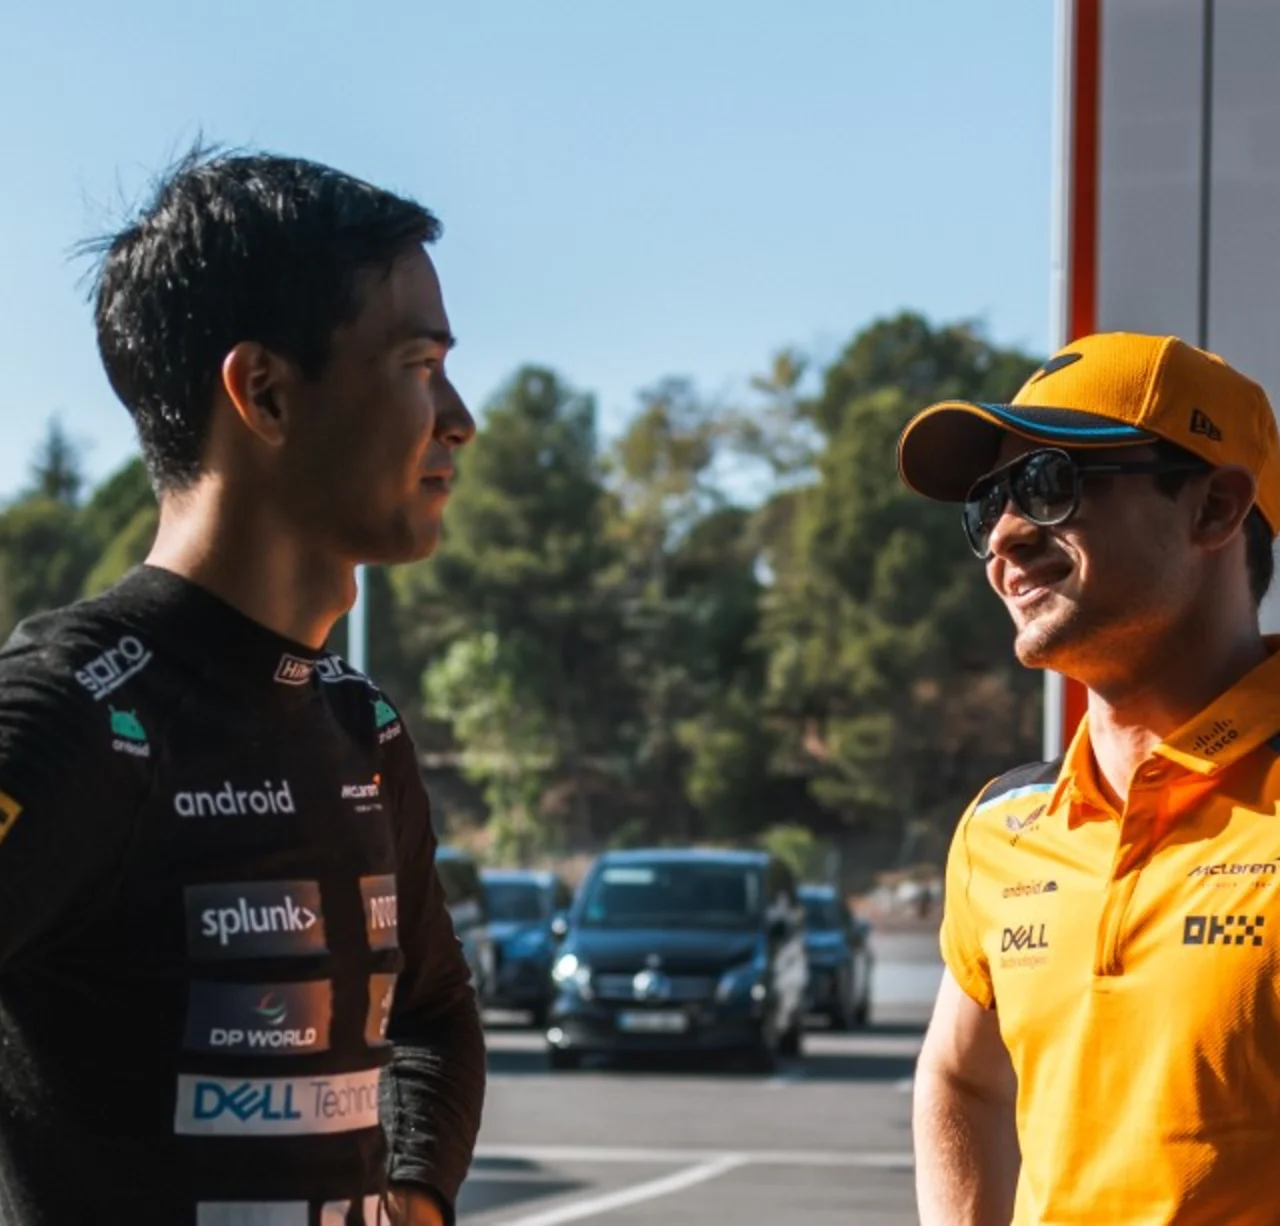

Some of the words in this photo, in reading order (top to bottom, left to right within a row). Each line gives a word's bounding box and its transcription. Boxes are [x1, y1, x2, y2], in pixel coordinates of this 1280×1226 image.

[175, 780, 296, 817] android
[1000, 923, 1049, 953] DELL
[1183, 914, 1266, 947] OKX
[209, 1028, 245, 1046] DP
[248, 1028, 317, 1047] WORLD
[191, 1080, 302, 1121] DELL
